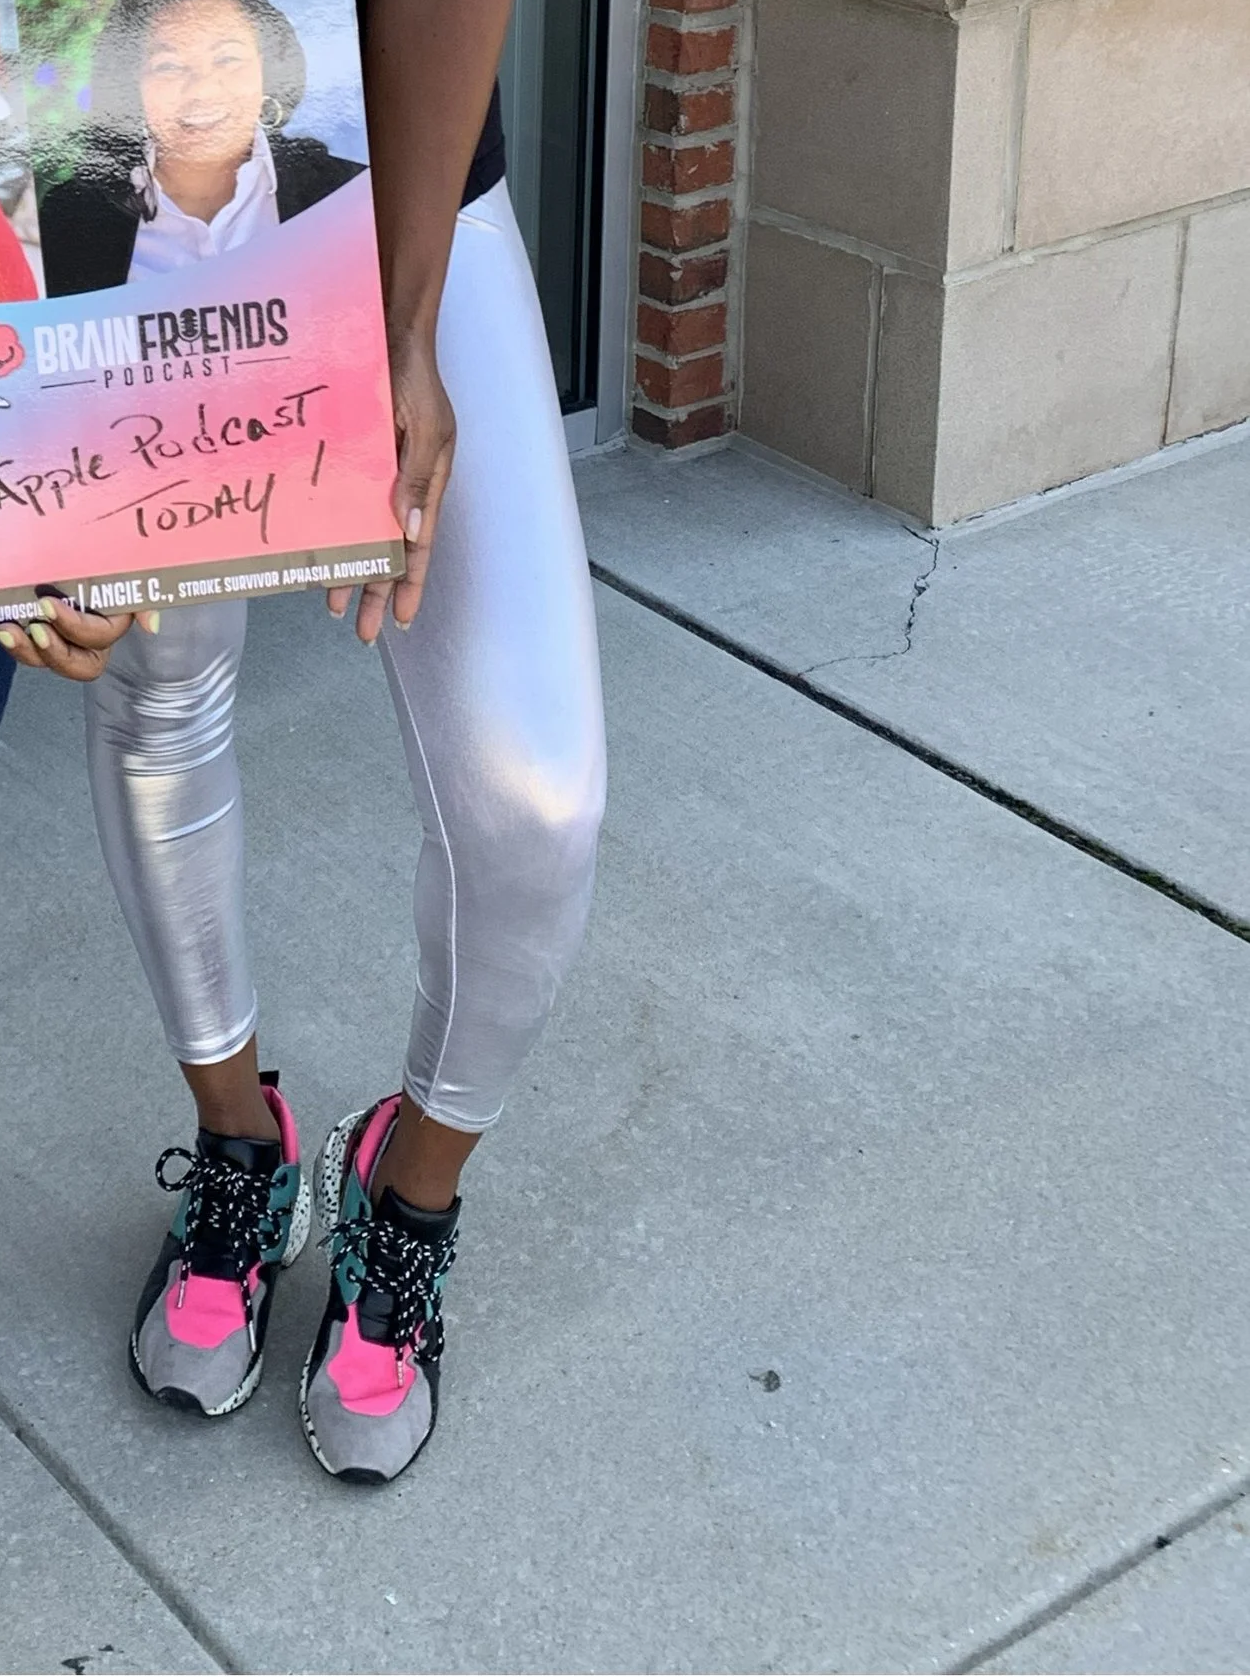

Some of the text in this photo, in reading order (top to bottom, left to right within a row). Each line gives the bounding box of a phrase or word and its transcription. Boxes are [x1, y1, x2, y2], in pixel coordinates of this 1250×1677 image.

[103, 355, 230, 389] PODCAST
[90, 579, 144, 610] ANGIE
[178, 577, 222, 599] STROKE
[224, 570, 280, 592] SURVIVOR
[282, 563, 332, 586] APHASIA
[333, 557, 392, 581] ADVOCATE
